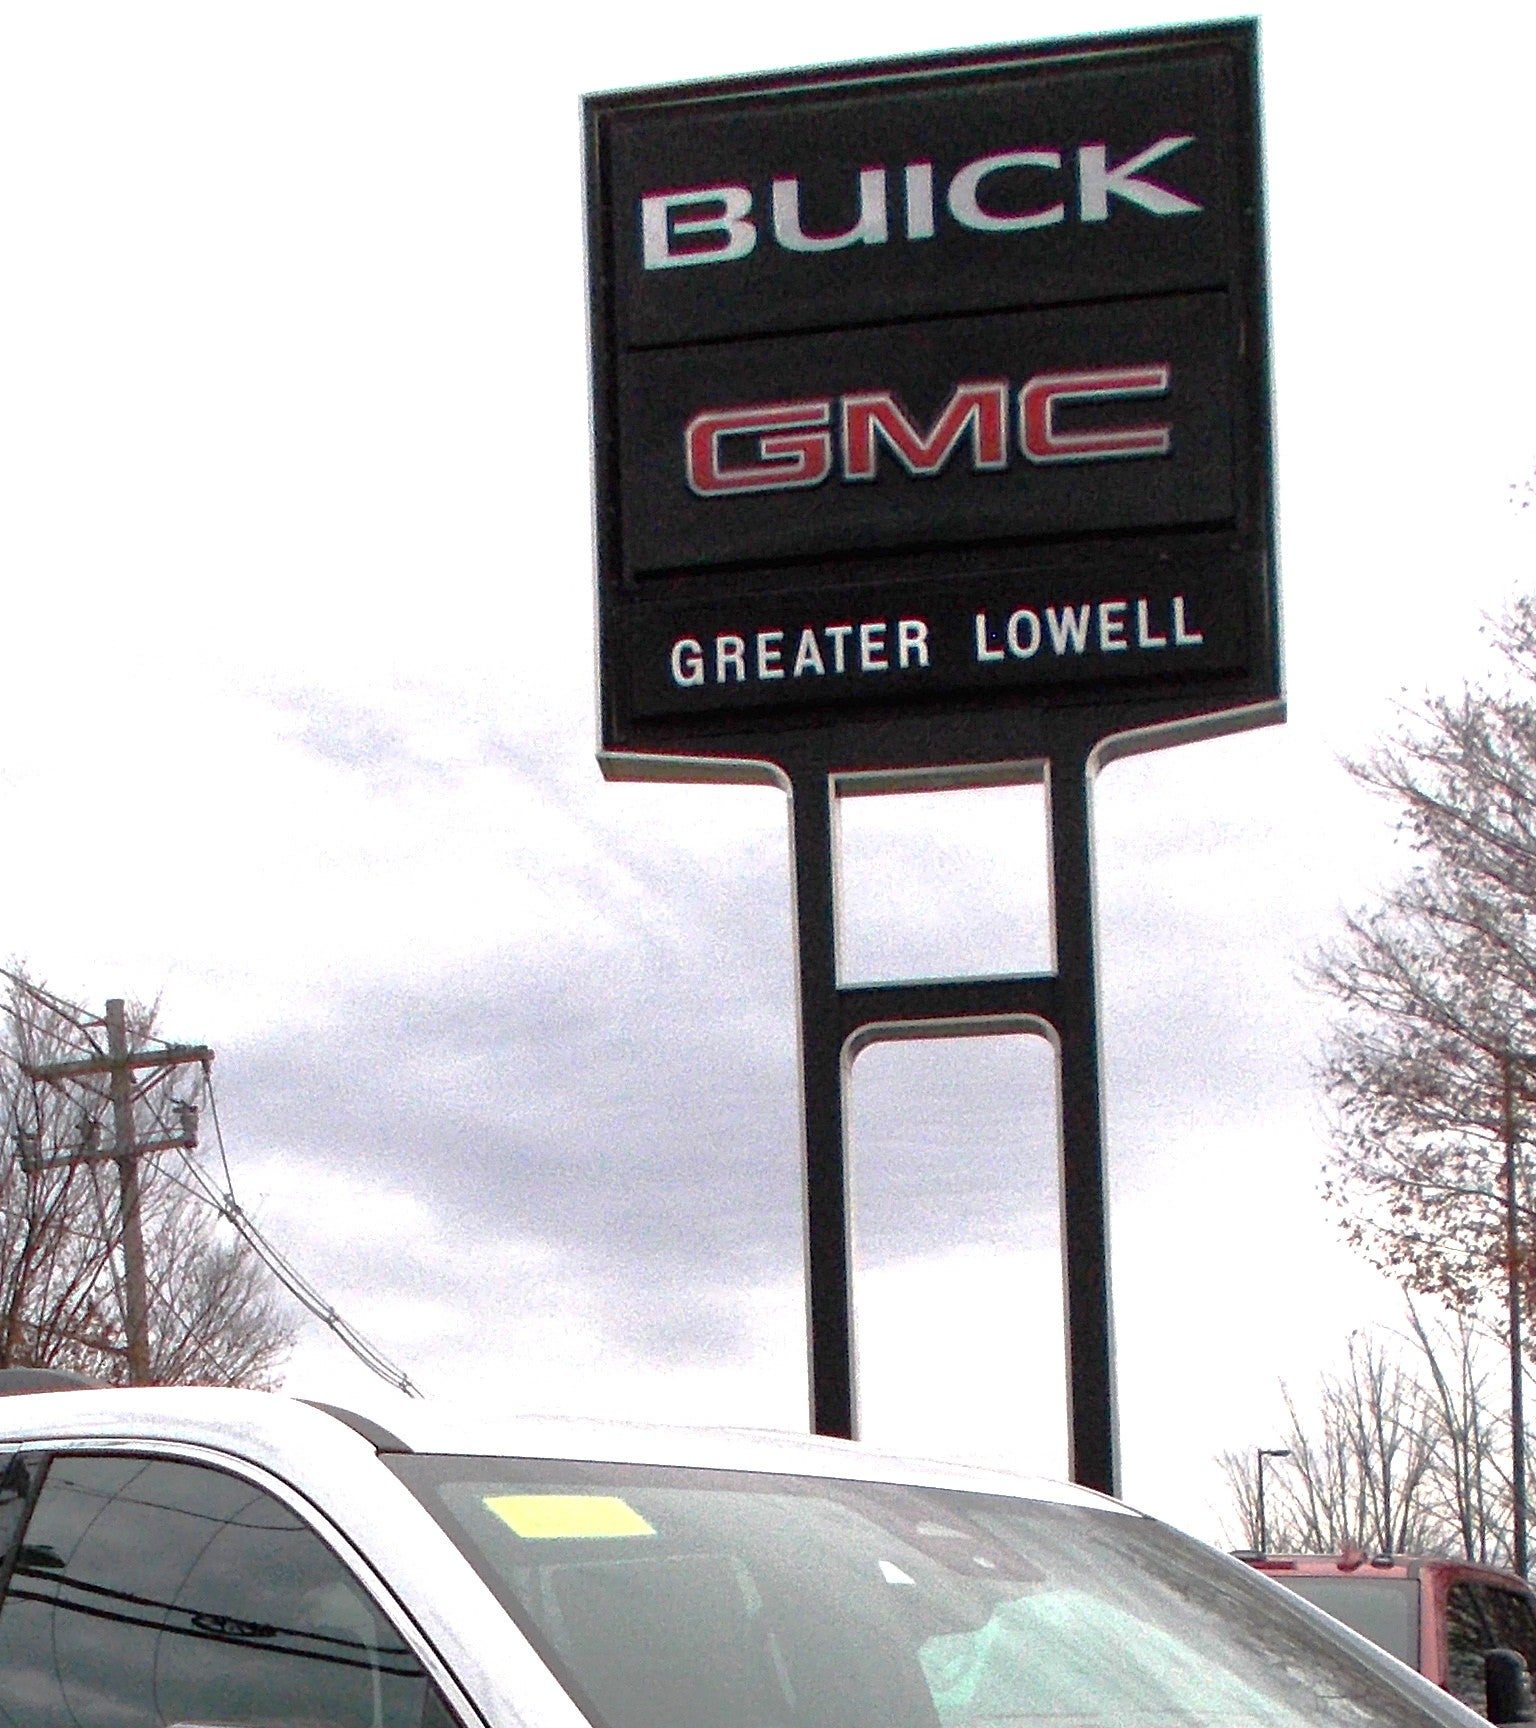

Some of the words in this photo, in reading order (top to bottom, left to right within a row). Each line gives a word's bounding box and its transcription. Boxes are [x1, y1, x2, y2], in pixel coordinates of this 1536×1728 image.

[641, 134, 1202, 271] BUICK
[685, 363, 1170, 499] GMC
[670, 618, 930, 689] GREATER
[975, 595, 1204, 662] LOWELL
